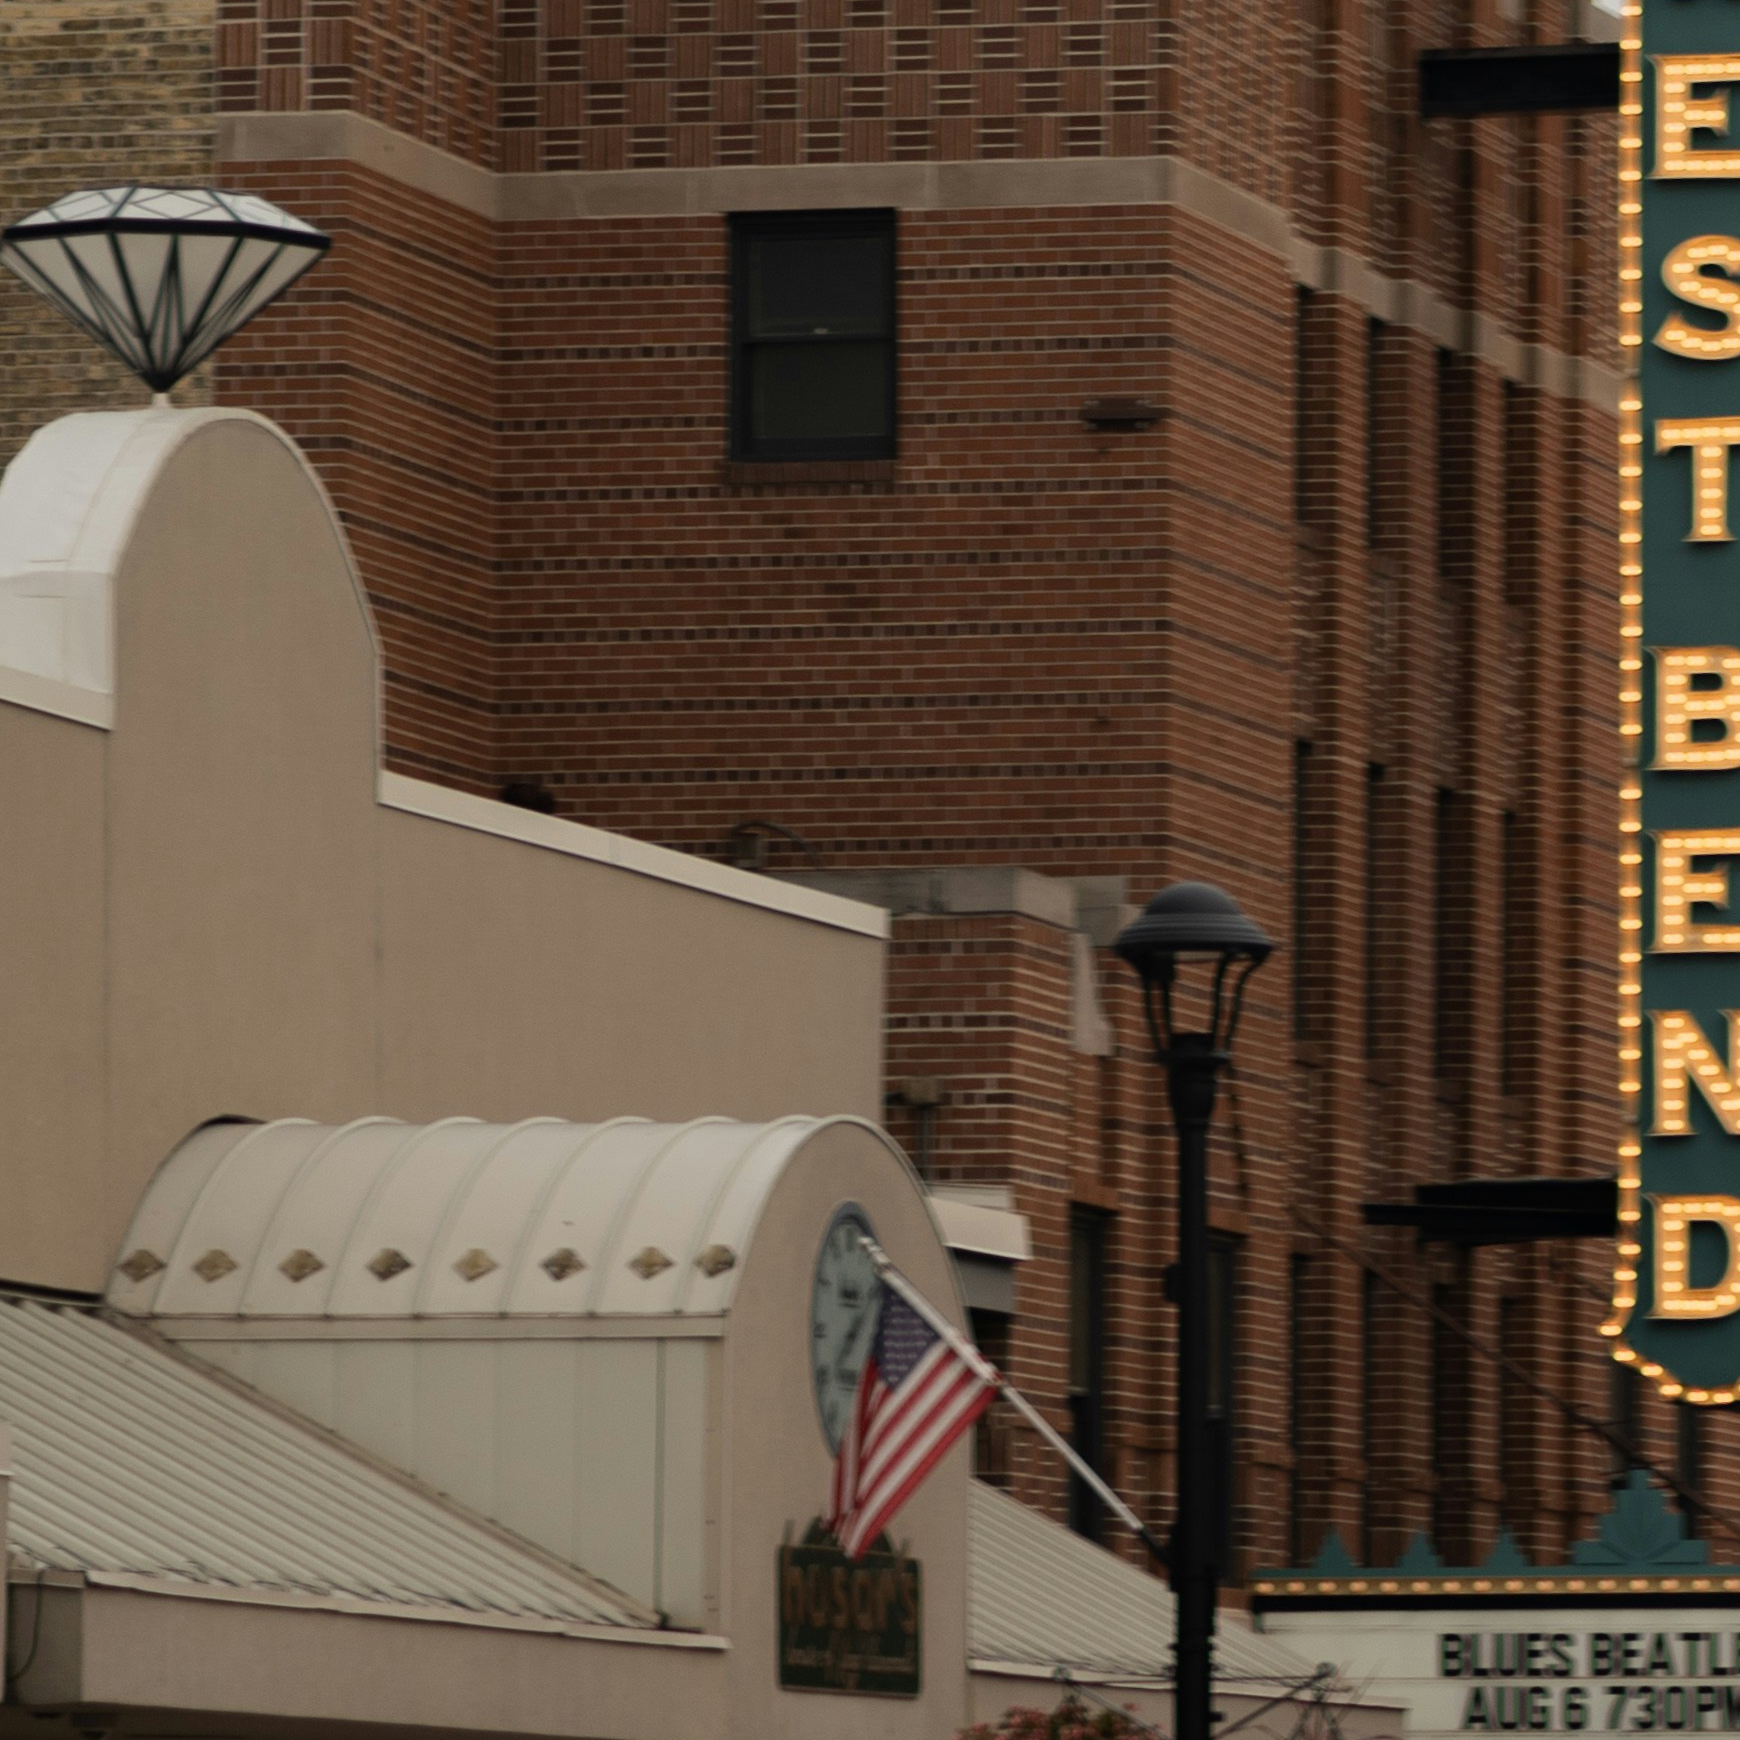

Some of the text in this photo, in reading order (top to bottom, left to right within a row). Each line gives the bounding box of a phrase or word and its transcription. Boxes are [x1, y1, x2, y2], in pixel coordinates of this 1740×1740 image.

[1438, 1632, 1576, 1678] BLUES
[1461, 1685, 1552, 1731] AUG
[1562, 1685, 1591, 1731] 6
